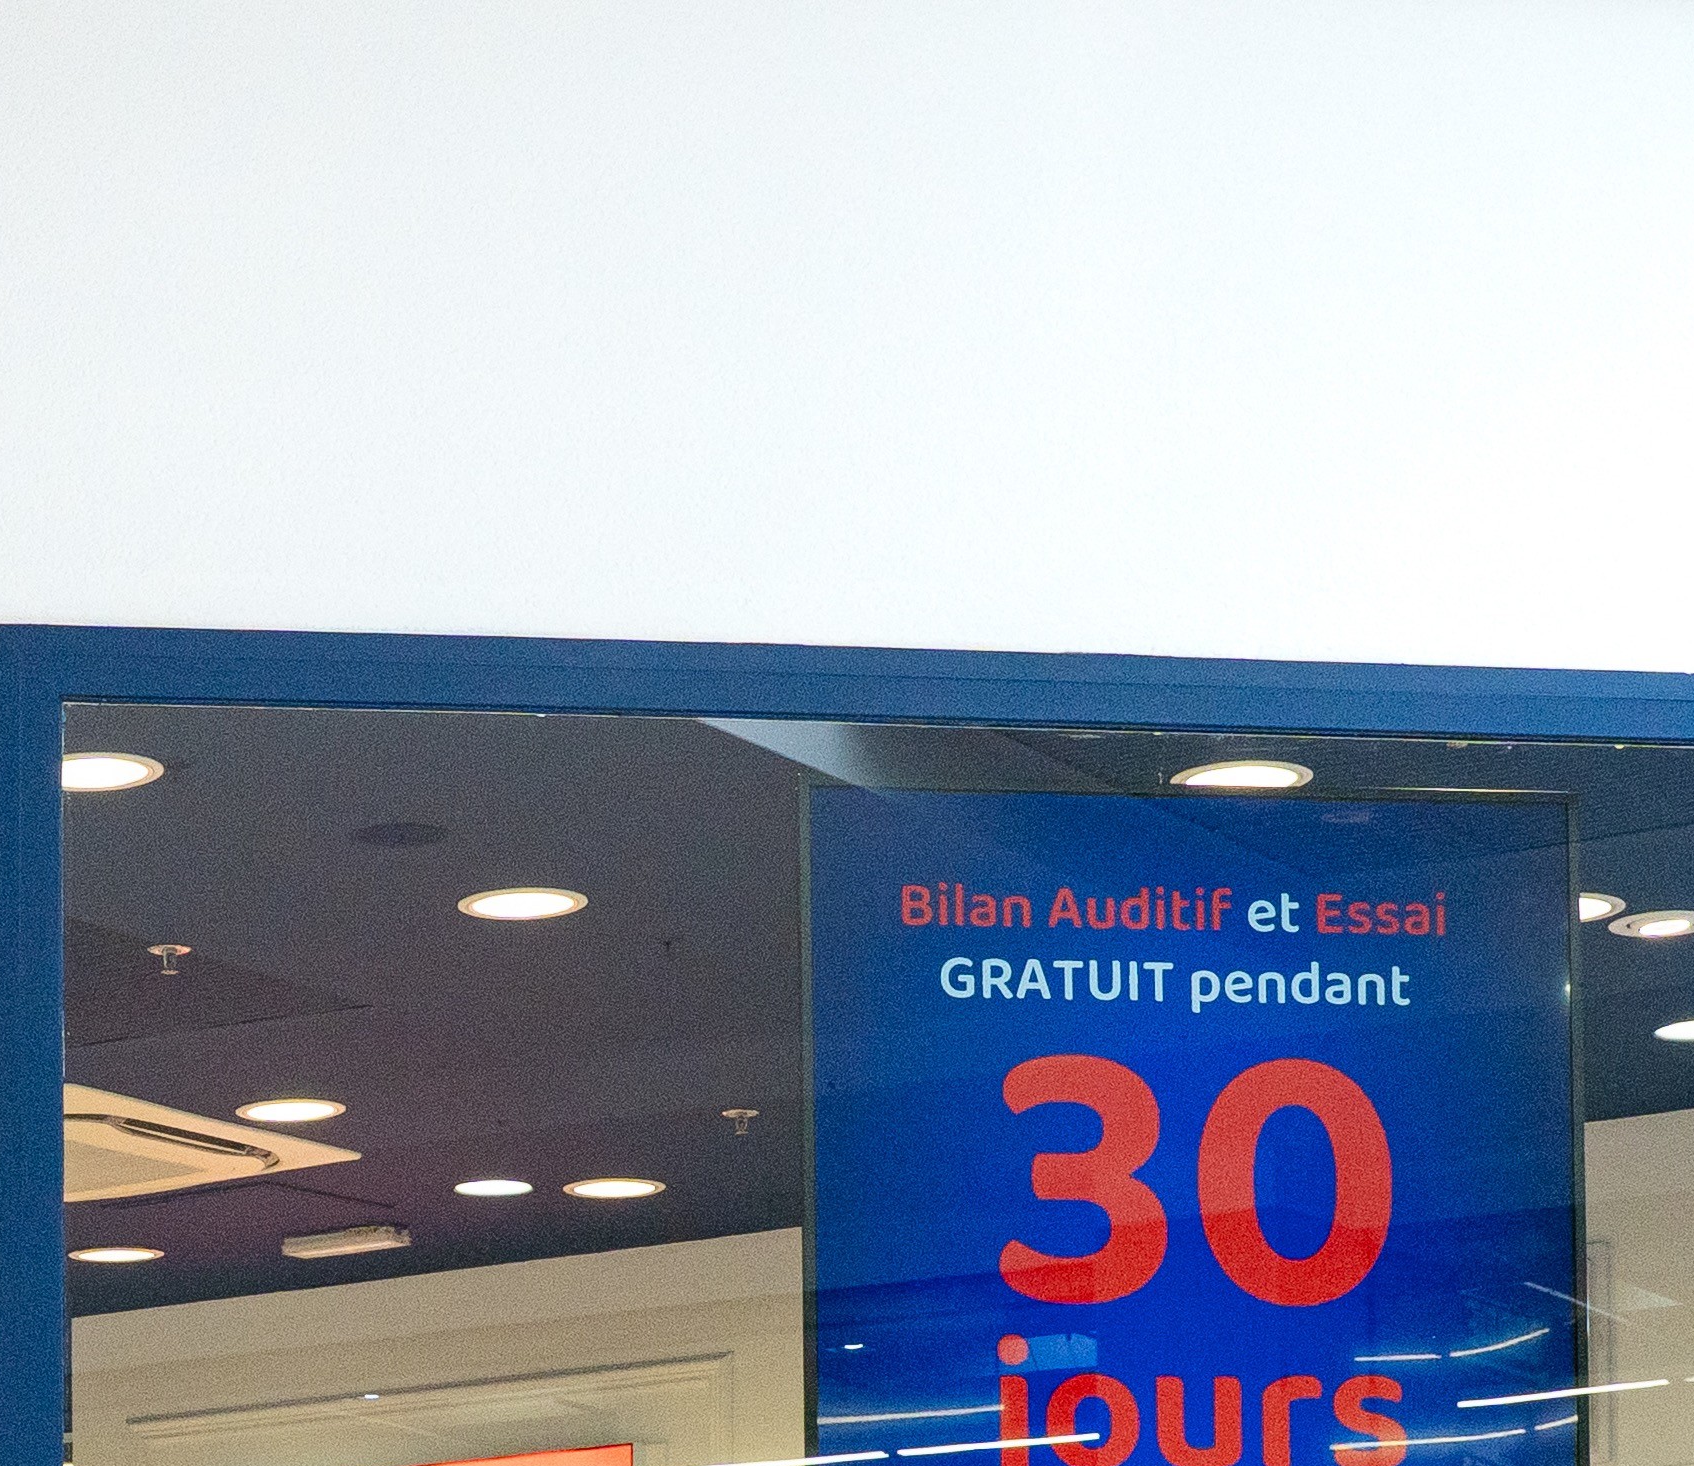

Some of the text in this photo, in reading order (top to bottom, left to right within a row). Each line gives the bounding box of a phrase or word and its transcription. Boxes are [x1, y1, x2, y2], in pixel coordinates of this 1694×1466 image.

[900, 883, 1448, 936] Bilan Auditif et Essai
[940, 957, 1411, 1014] GRATUIT pendant
[999, 1053, 1392, 1307] 30
